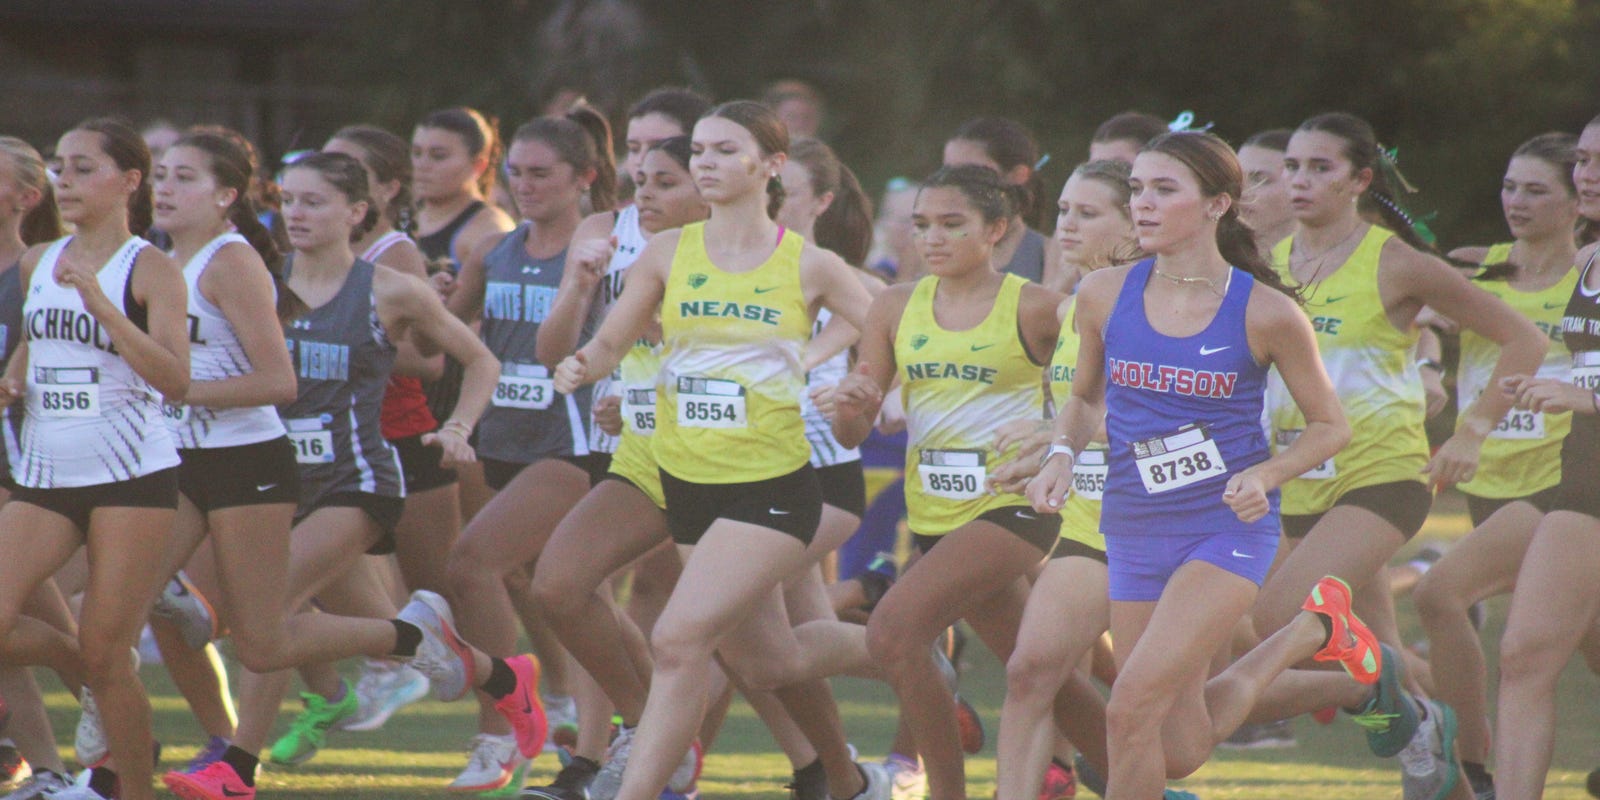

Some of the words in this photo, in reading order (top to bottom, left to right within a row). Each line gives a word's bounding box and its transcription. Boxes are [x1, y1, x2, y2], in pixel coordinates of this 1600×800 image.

[680, 301, 781, 326] NEASE
[906, 363, 998, 385] NEASE
[1109, 358, 1238, 398] WOLFSON
[43, 391, 91, 410] 8356
[496, 382, 544, 402] 8623
[685, 401, 737, 421] 8554
[1149, 451, 1212, 484] 8738
[928, 472, 977, 493] 8550
